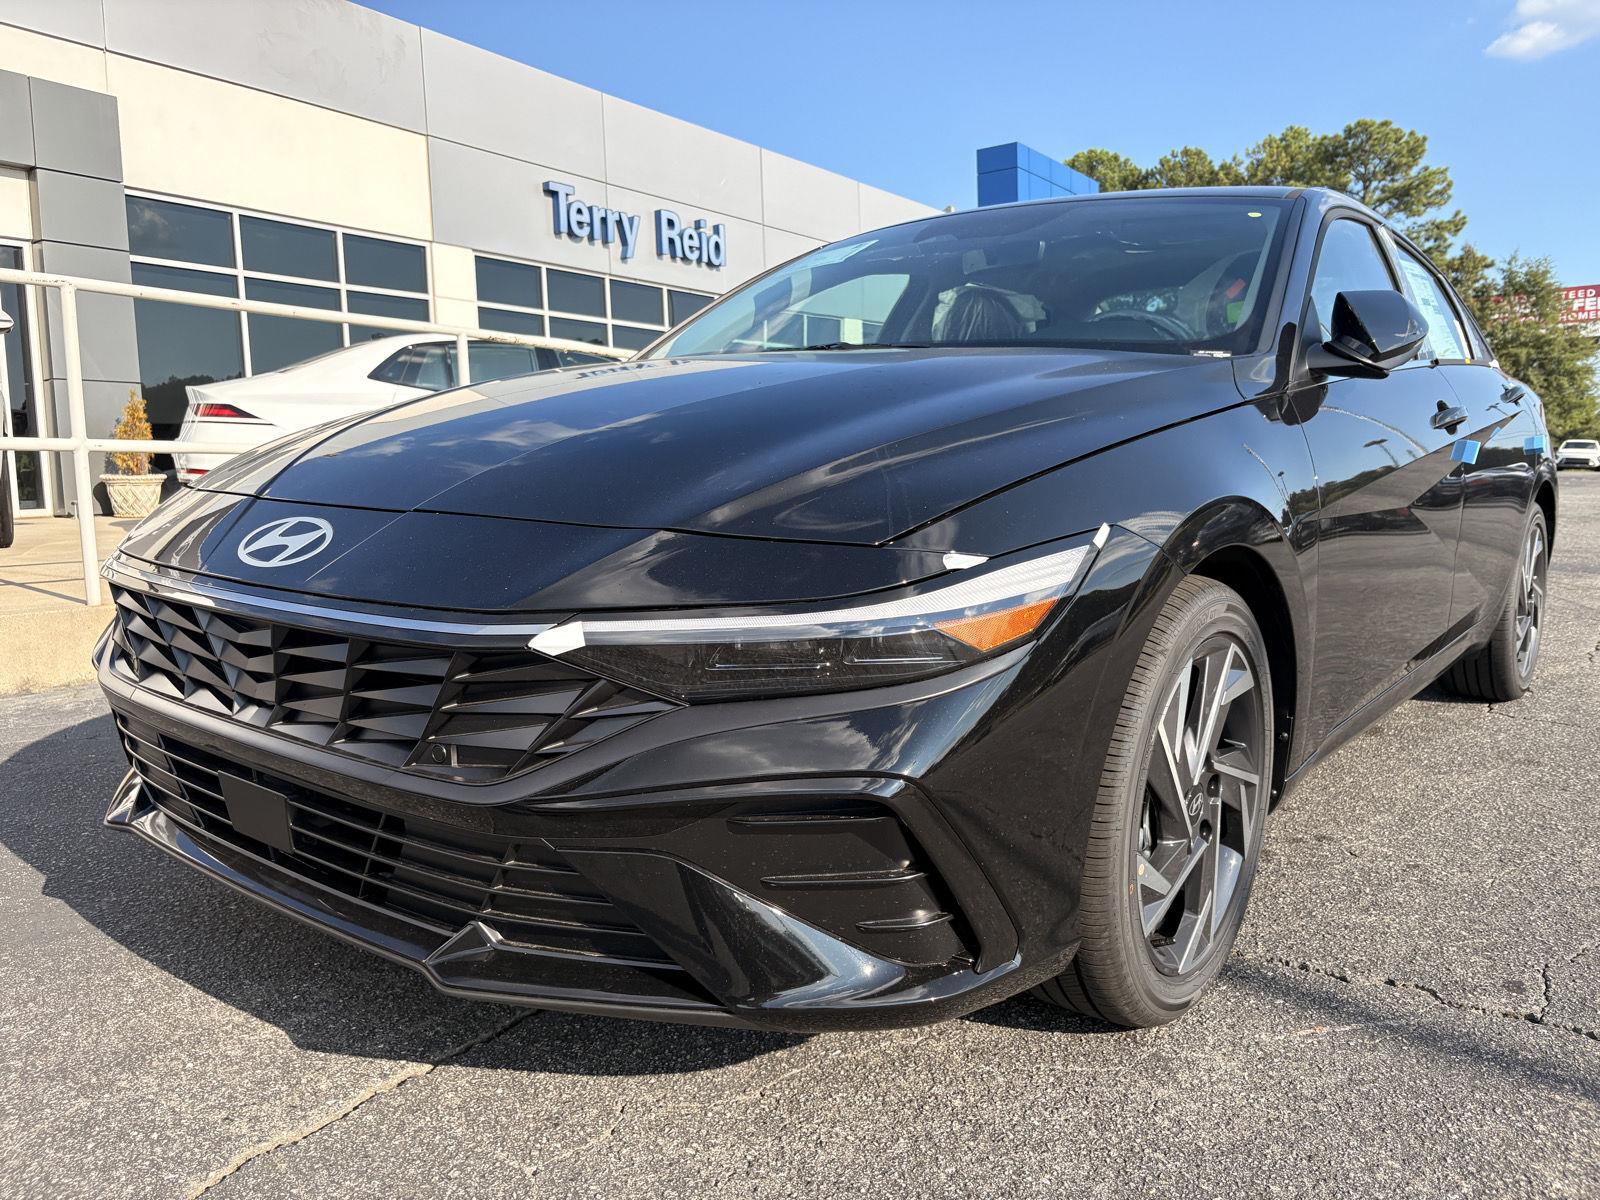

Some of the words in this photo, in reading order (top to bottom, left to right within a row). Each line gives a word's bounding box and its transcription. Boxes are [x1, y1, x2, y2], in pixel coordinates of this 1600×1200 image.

[543, 181, 640, 259] Terry
[655, 209, 726, 267] Reid
[1561, 289, 1595, 299] TEED
[1572, 297, 1600, 311] FE
[1559, 310, 1600, 321] HOME
